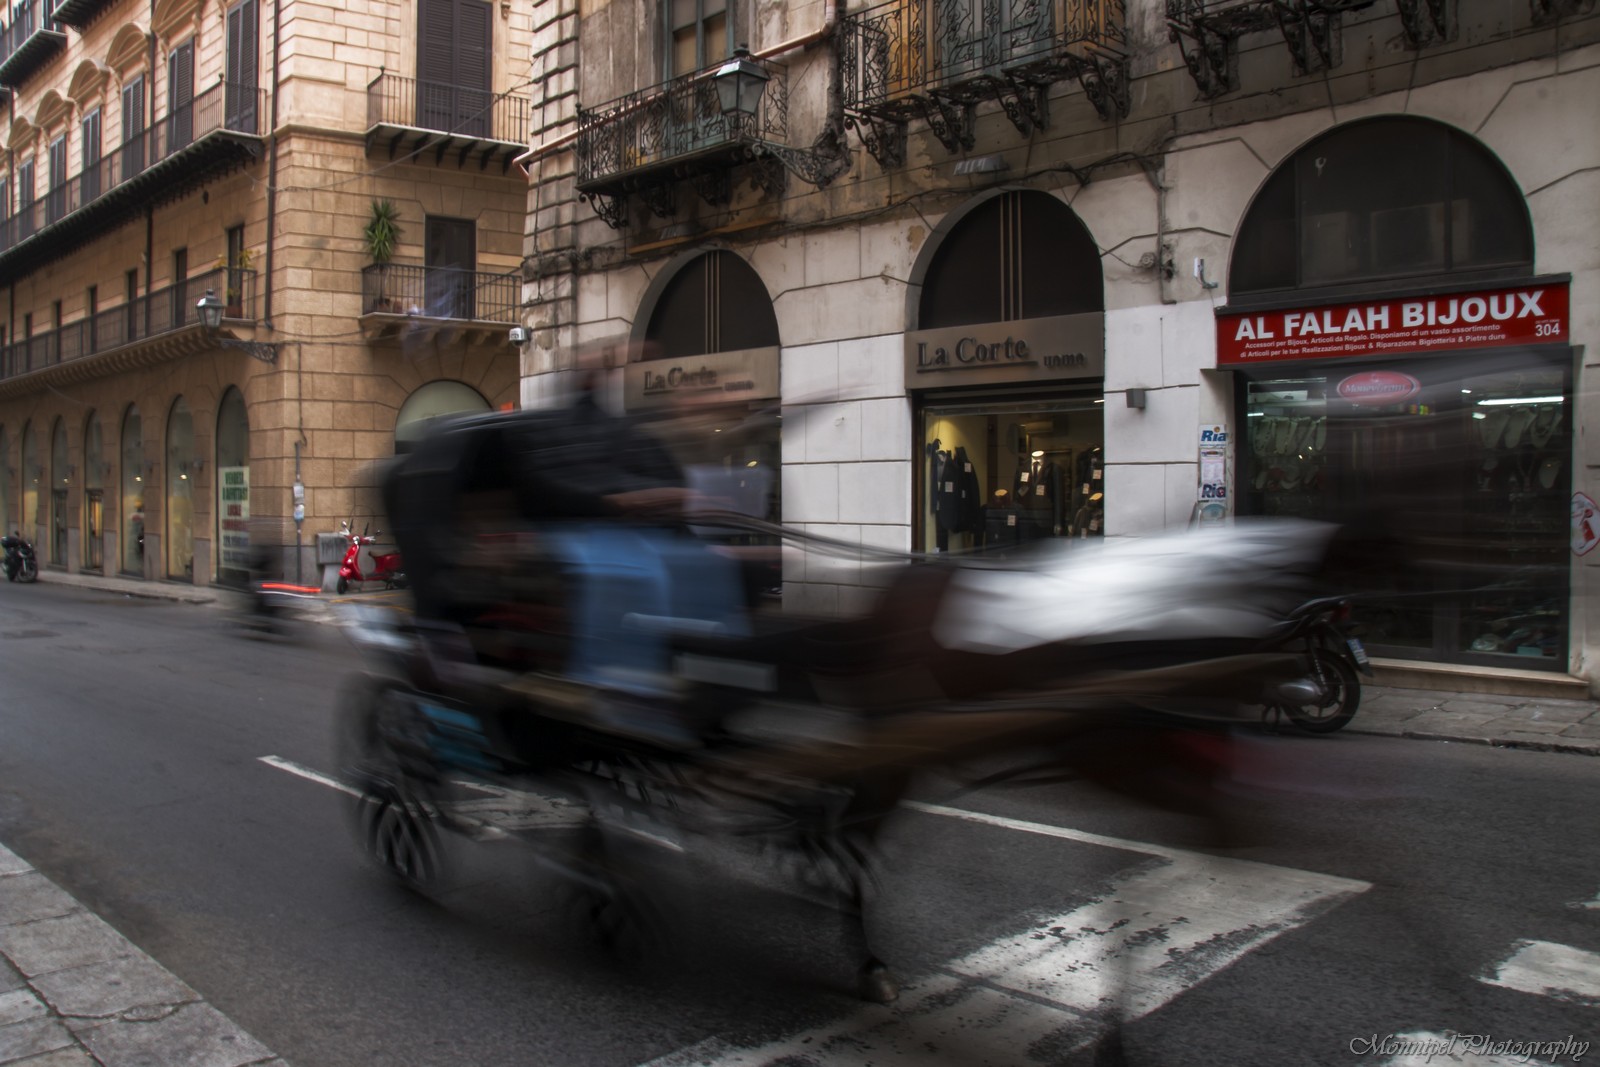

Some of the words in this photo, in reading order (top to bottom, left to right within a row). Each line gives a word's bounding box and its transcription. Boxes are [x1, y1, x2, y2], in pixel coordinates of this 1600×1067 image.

[1235, 316, 1274, 341] AL
[1284, 306, 1389, 336] FALAH
[1402, 290, 1546, 328] BIJOUX
[1245, 340, 1275, 349] Accessori
[1276, 340, 1286, 348] per
[1311, 336, 1334, 344] Articoli
[1370, 331, 1410, 340] Disponiamo
[1430, 327, 1450, 335] vasto
[1452, 324, 1501, 334] assortimento
[1535, 322, 1560, 337] 304
[917, 342, 948, 367] La
[955, 335, 1029, 364] Corte
[1248, 349, 1270, 357] Articoli
[1302, 345, 1343, 354] Realizzazioni
[1344, 343, 1366, 352] Bijoux
[1376, 339, 1417, 348] Riparazione
[1419, 336, 1456, 346] Bigiotteria
[1465, 334, 1487, 342] Pietre
[643, 370, 666, 391] La
[1201, 426, 1227, 442] Ria
[1201, 484, 1227, 498] Ria
